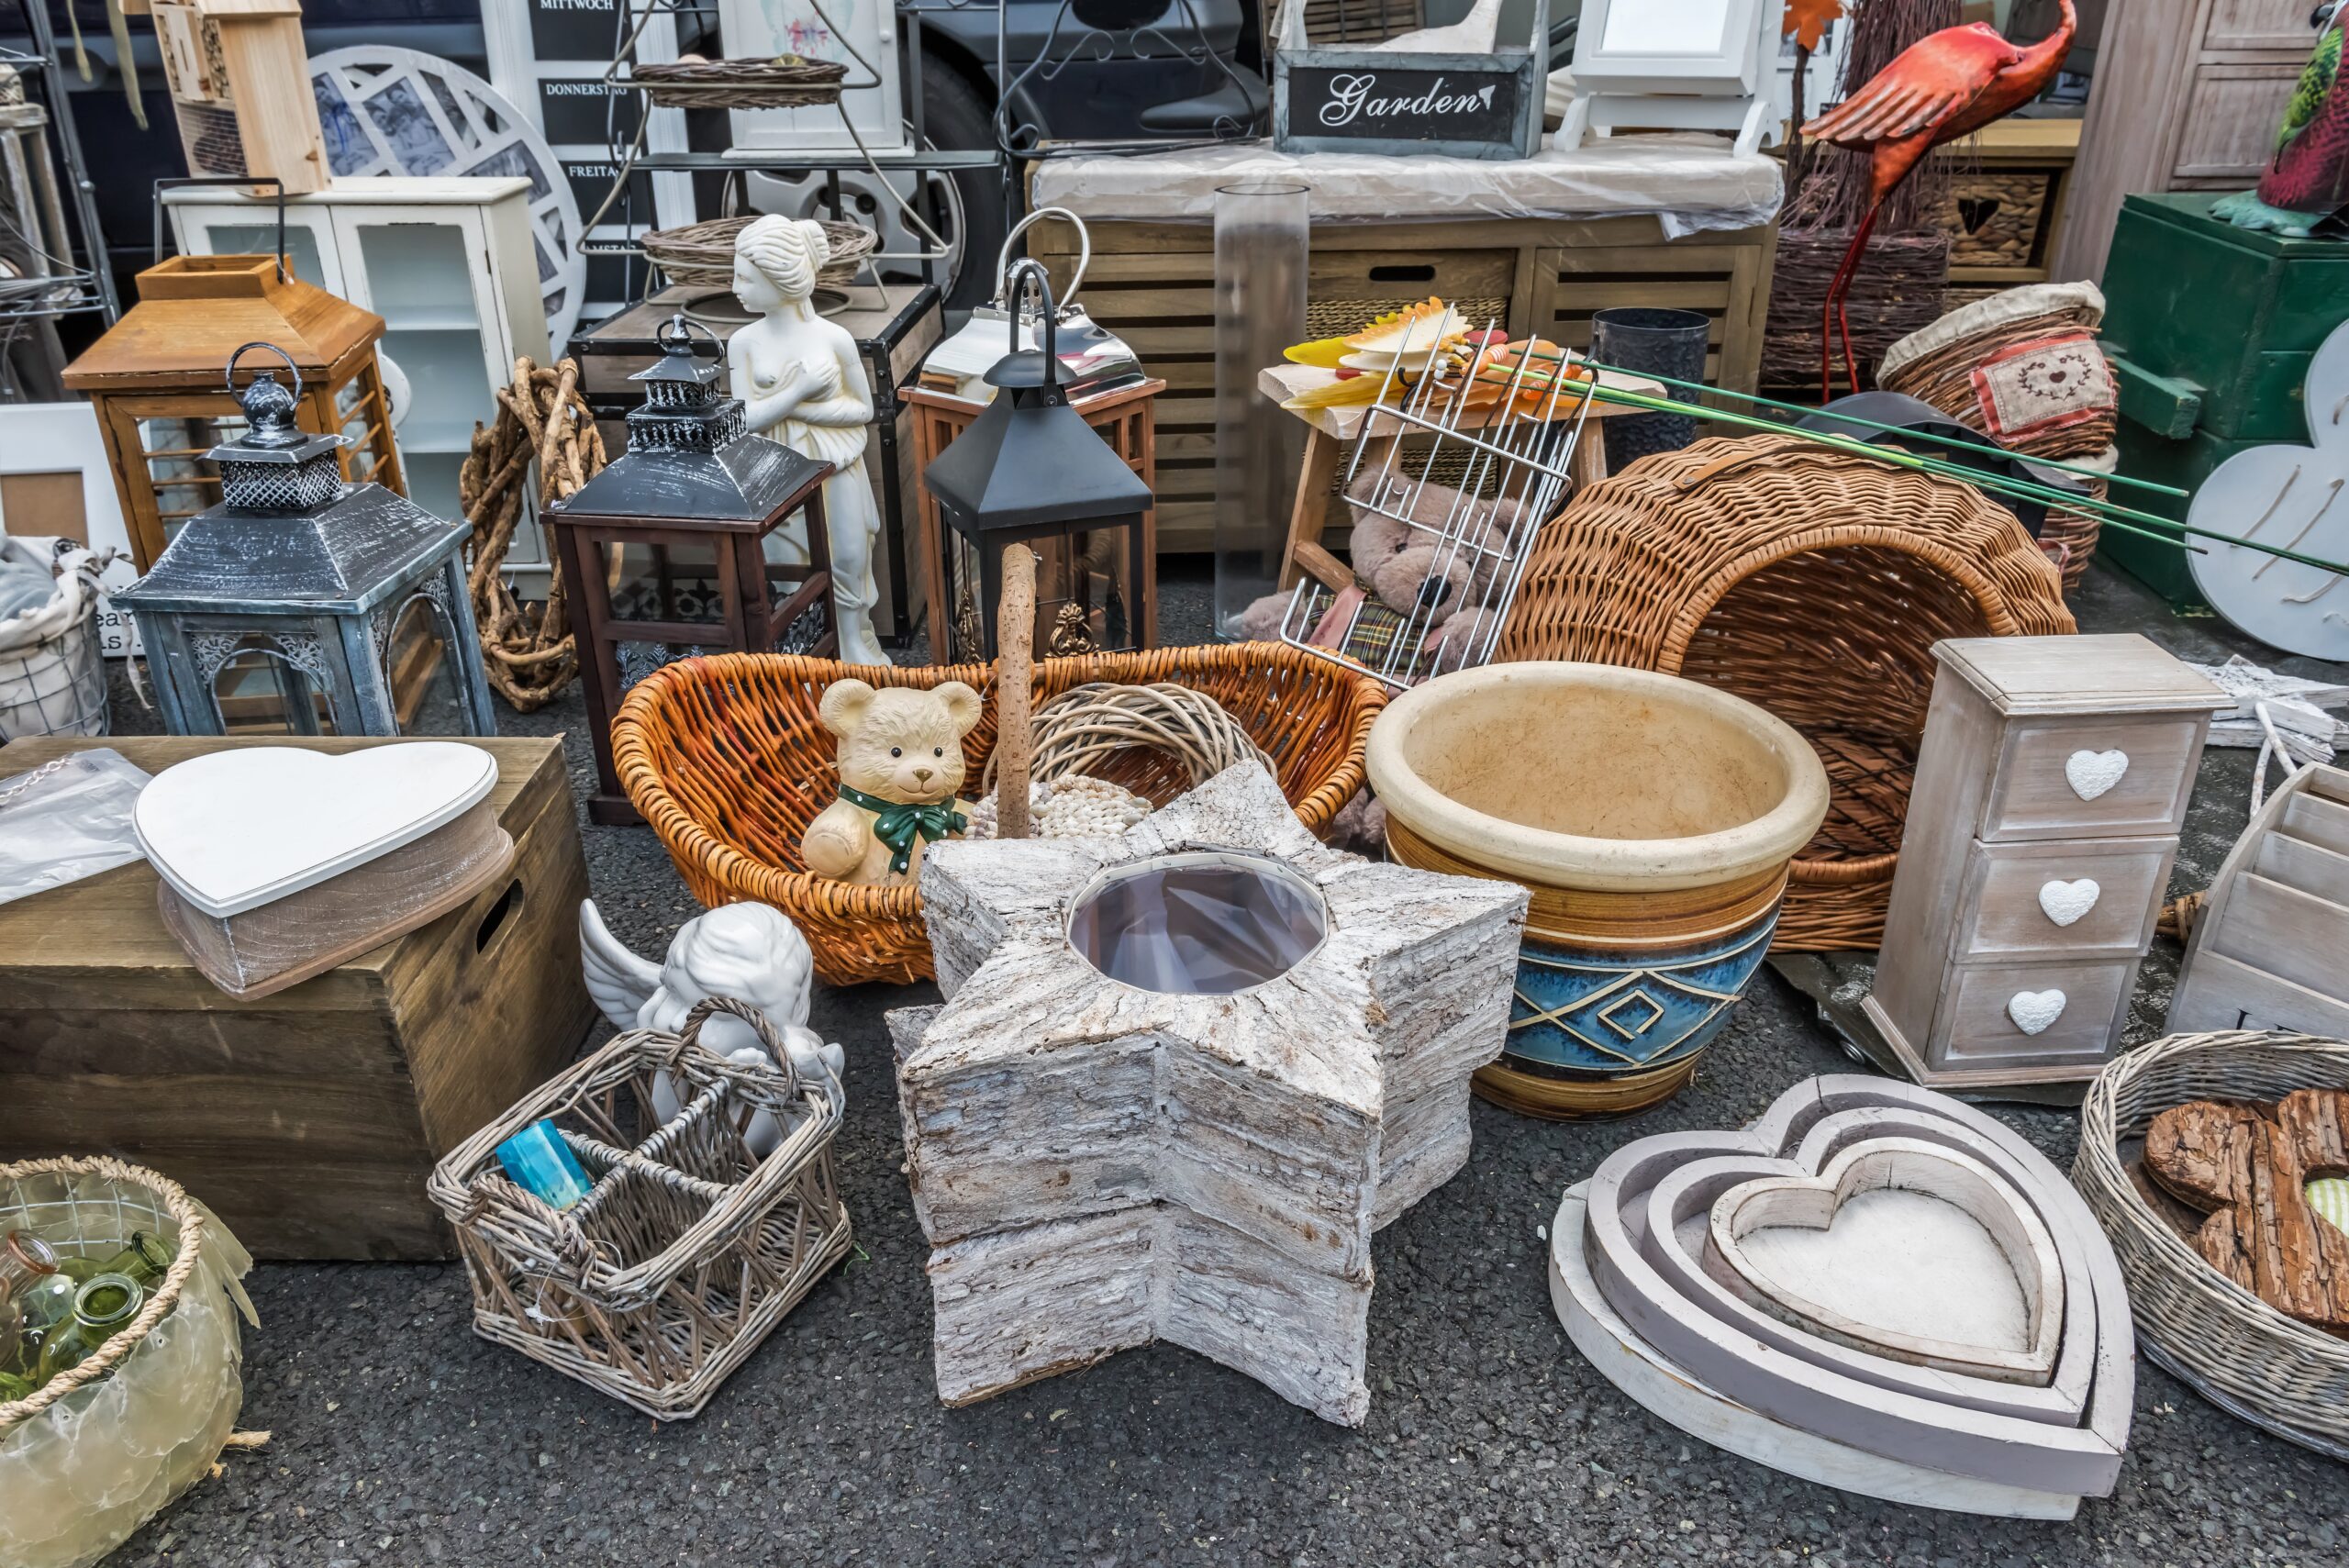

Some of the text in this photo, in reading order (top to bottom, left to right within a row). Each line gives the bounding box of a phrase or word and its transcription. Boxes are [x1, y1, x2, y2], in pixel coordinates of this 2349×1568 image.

[540, 0, 615, 10] MITTWOCH
[1319, 72, 1483, 127] Garden
[569, 166, 619, 177] FREITA
